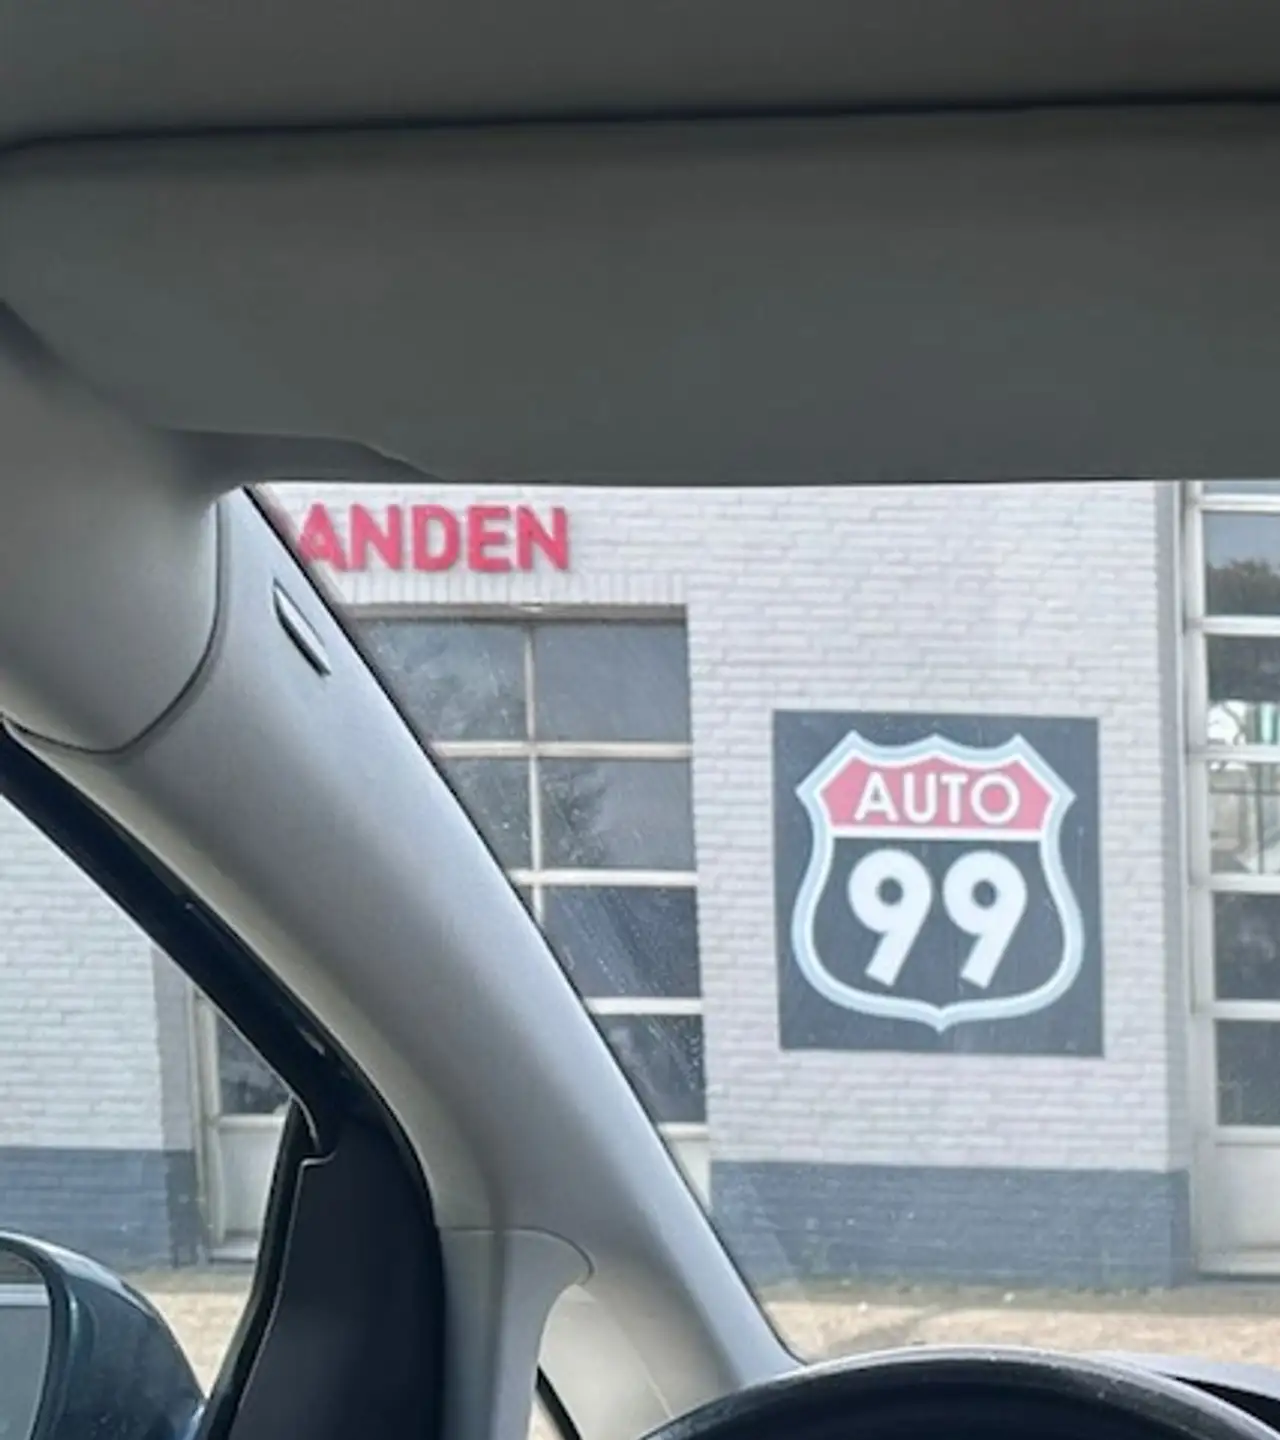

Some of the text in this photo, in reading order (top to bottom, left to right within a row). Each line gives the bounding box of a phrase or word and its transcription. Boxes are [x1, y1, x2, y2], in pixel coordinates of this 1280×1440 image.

[298, 503, 570, 572] ANDEN
[854, 773, 1021, 826] AUTO
[847, 848, 1028, 990] 99
